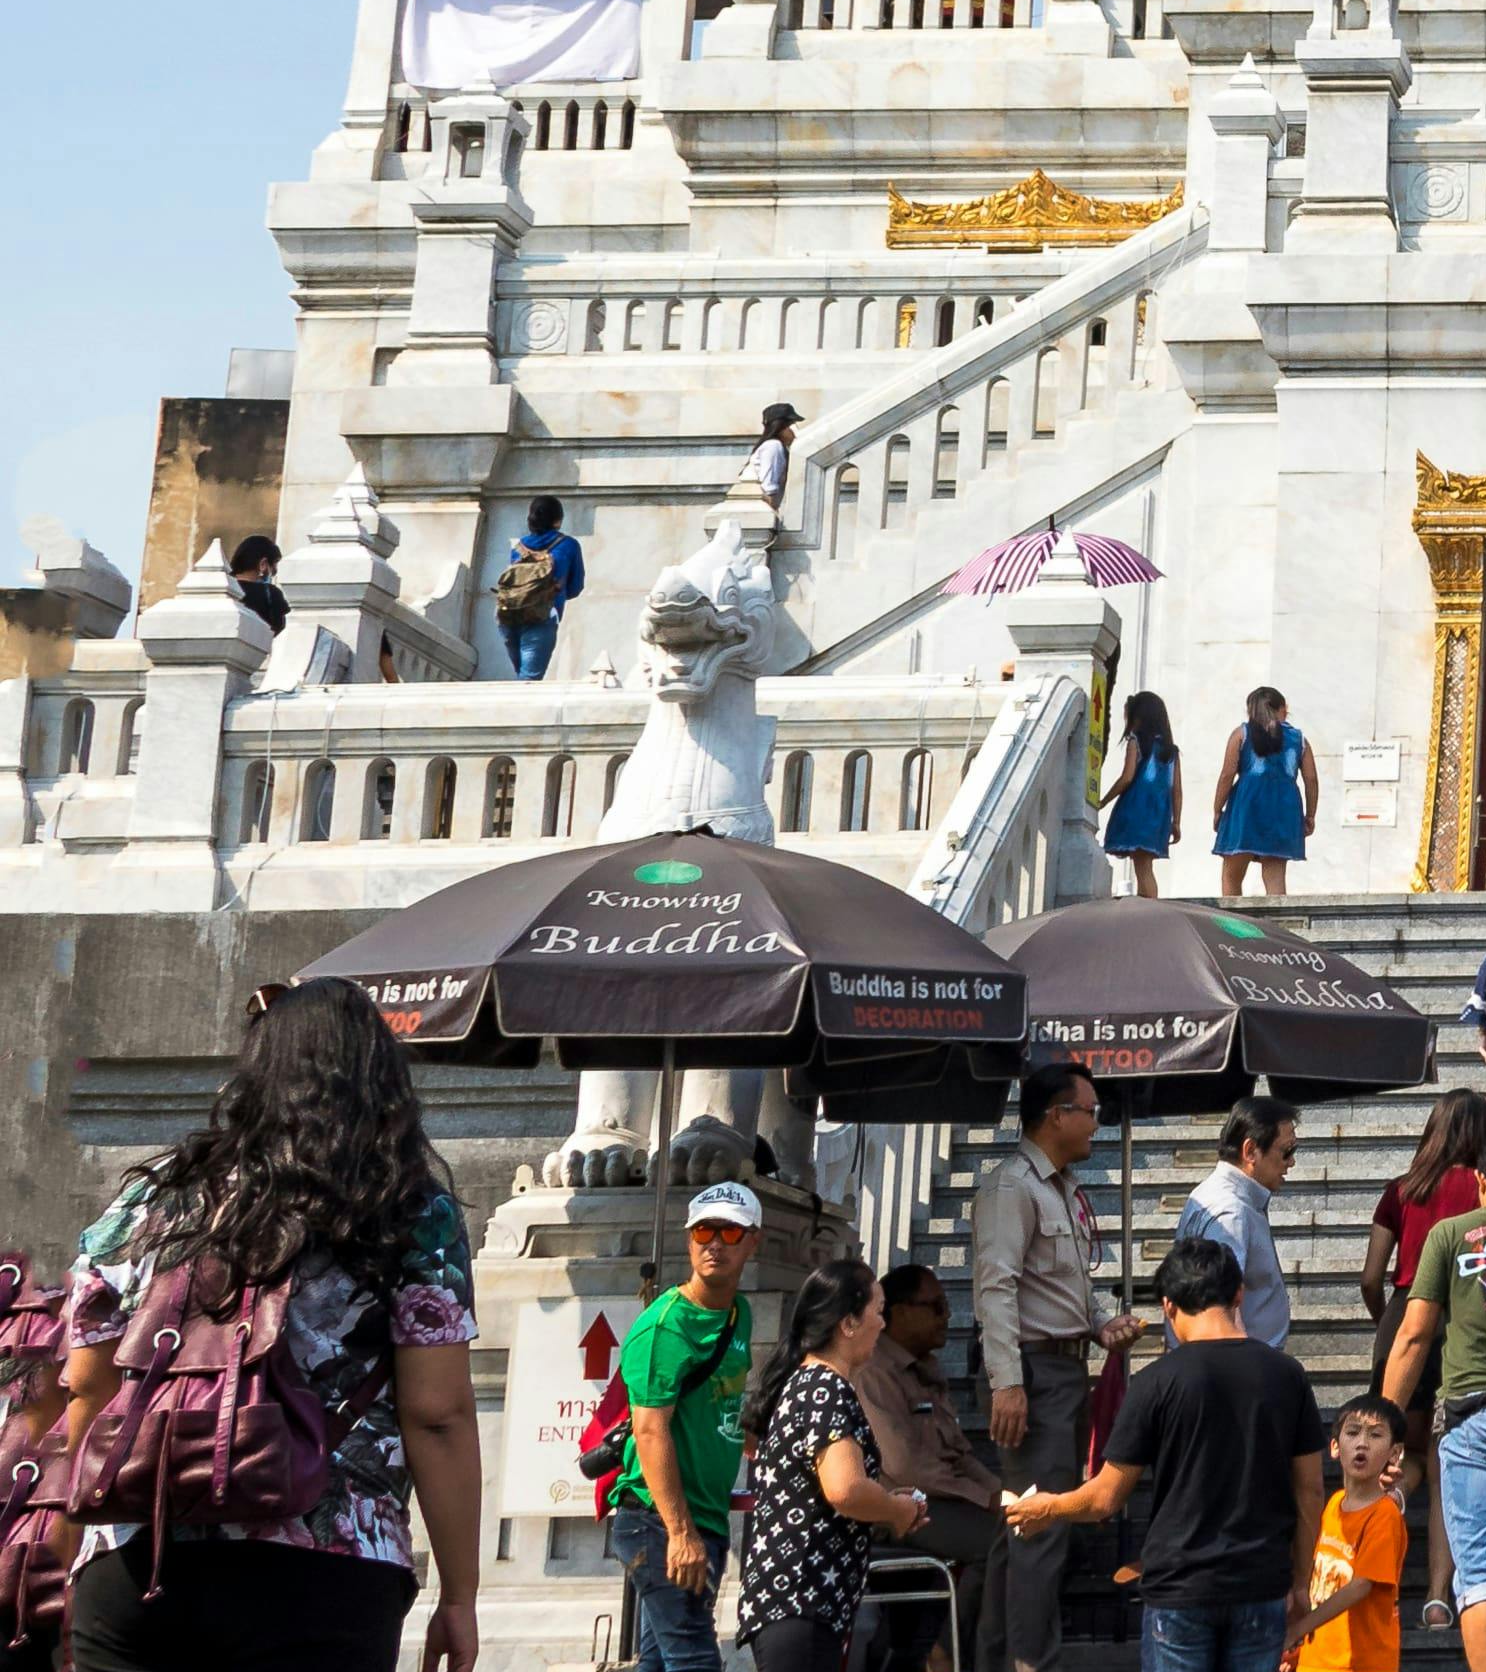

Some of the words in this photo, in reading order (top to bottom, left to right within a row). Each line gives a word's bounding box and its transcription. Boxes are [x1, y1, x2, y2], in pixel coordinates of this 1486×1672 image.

[587, 890, 743, 914] Knowing
[529, 920, 783, 954] Buddha
[1218, 943, 1326, 972] Knowing
[381, 979, 401, 1003] is
[403, 977, 438, 1002] not
[440, 975, 469, 999] for
[828, 971, 905, 998] Buddha
[911, 976, 929, 999] is
[934, 978, 968, 1000] not
[973, 977, 1004, 1000] for
[1230, 975, 1394, 1010] Buddha
[853, 1007, 983, 1029] DECORATION
[1093, 1019, 1116, 1042] is
[1122, 1017, 1165, 1040] not
[1172, 1016, 1208, 1038] for
[1054, 1047, 1154, 1069] ATTOO
